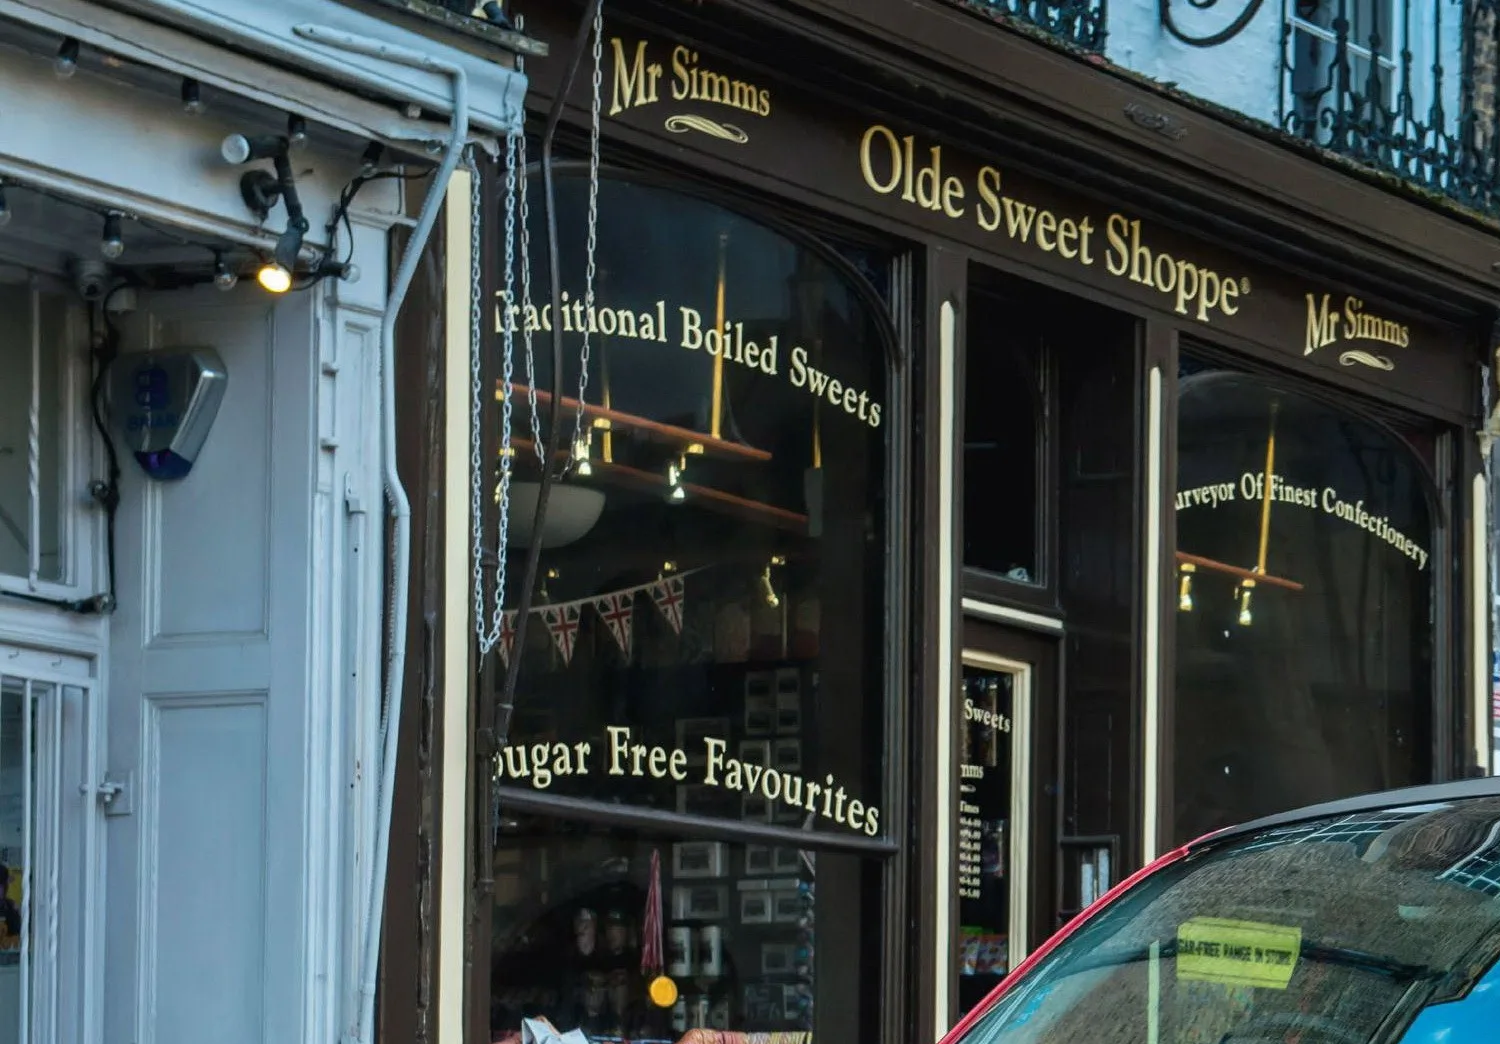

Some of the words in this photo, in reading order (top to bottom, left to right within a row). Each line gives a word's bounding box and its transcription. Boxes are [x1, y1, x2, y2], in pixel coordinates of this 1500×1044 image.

[609, 38, 661, 116] Mr
[671, 44, 770, 117] Simms
[860, 125, 965, 218] Olde
[977, 165, 1095, 265] Sweet
[680, 306, 778, 376] Boiled
[789, 347, 882, 428] Sweets
[1303, 293, 1339, 357] Mr
[1344, 296, 1409, 349] Simms
[1174, 481, 1236, 511] urveyor
[1241, 472, 1265, 501] Of
[1269, 474, 1318, 509] Finest
[1322, 487, 1429, 572] Confectionery
[964, 698, 1011, 734] Sweets
[606, 725, 688, 781] Free
[703, 736, 880, 836] Favourites
